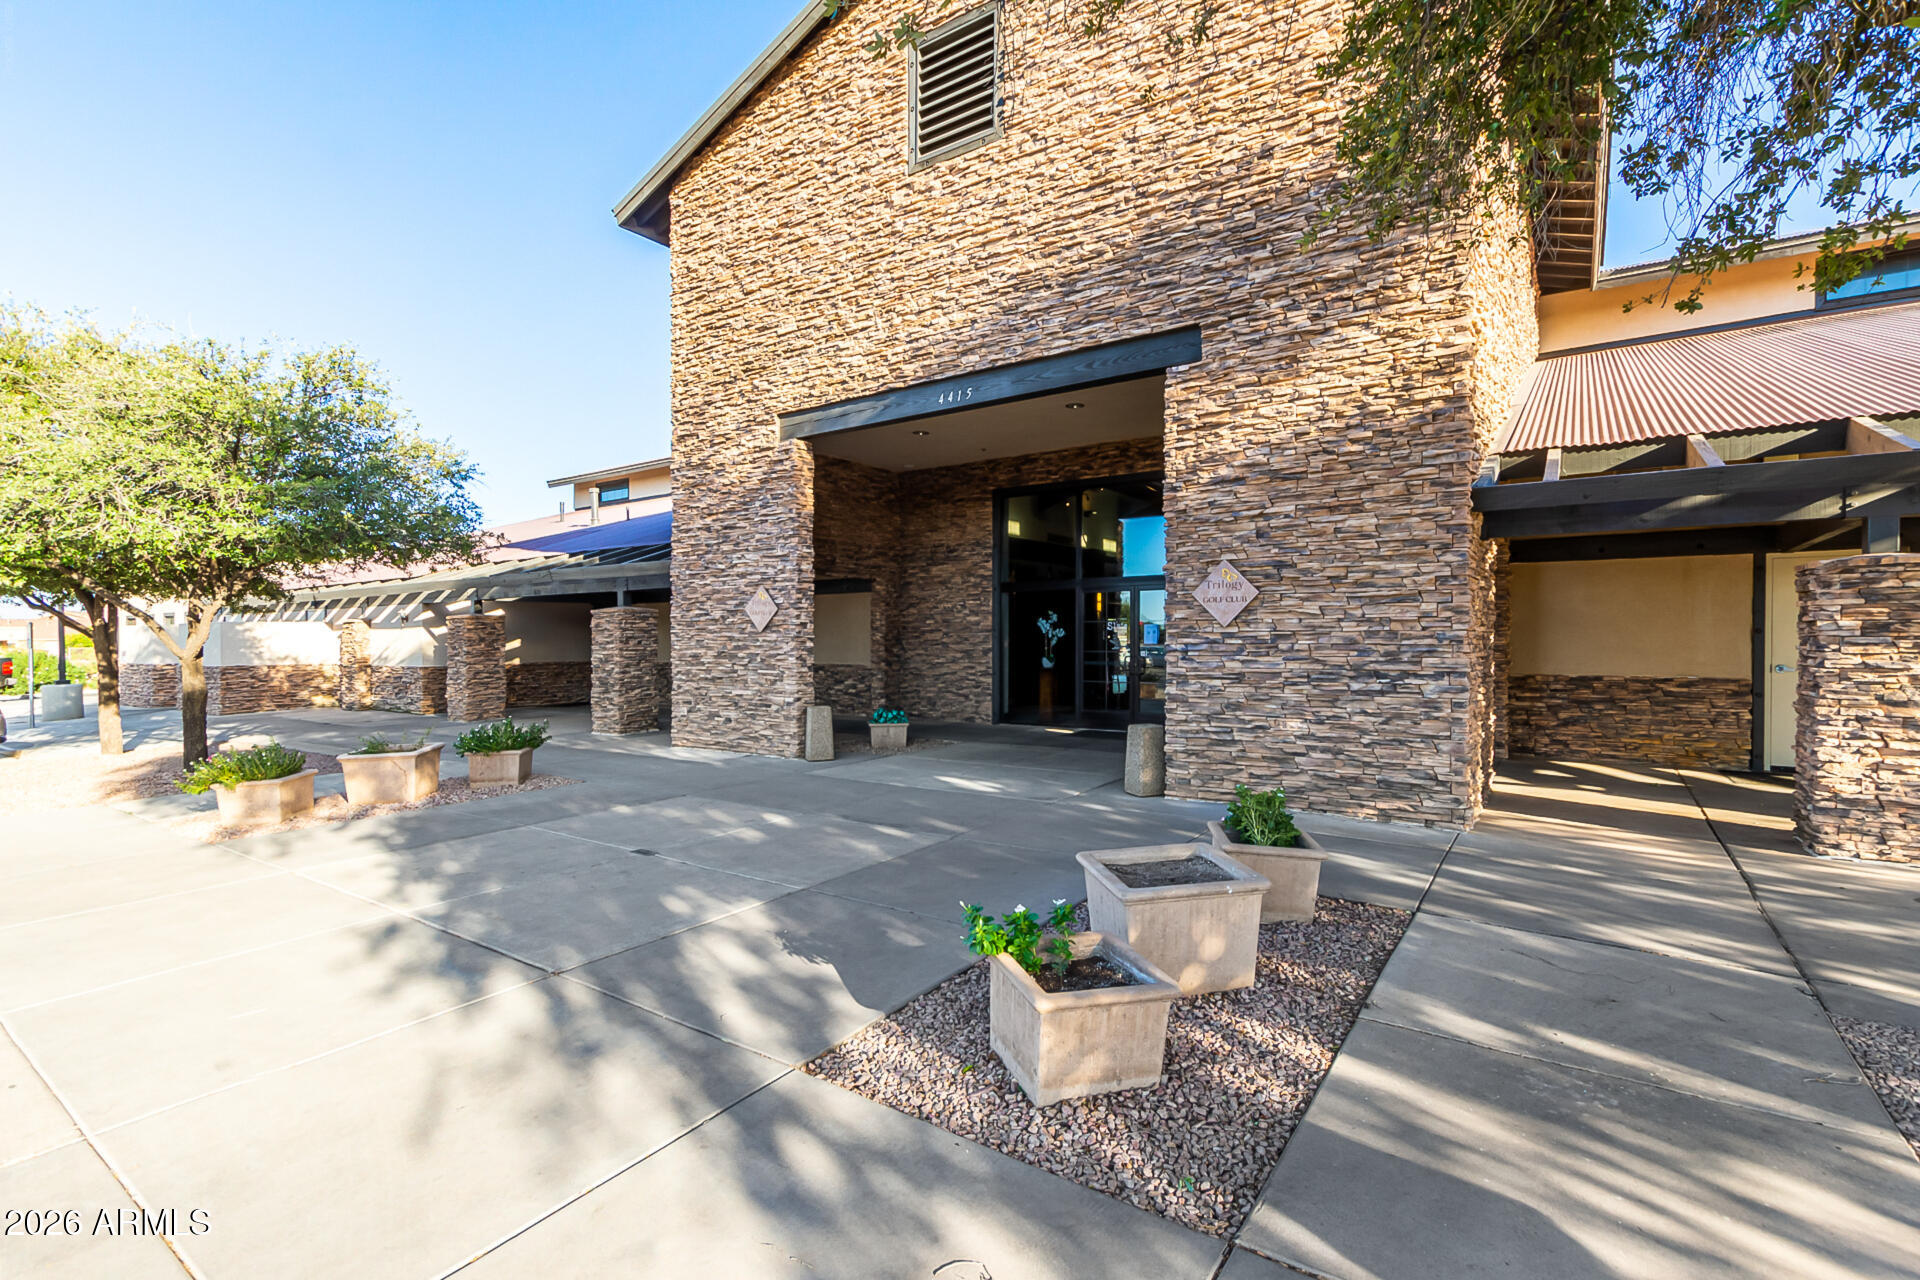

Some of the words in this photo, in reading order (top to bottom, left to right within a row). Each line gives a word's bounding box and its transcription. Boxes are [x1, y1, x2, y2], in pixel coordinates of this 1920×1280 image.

[938, 387, 973, 405] 4415
[1205, 579, 1244, 591] Trilogy
[1202, 595, 1224, 604] GOLF
[1225, 595, 1248, 604] CLUB
